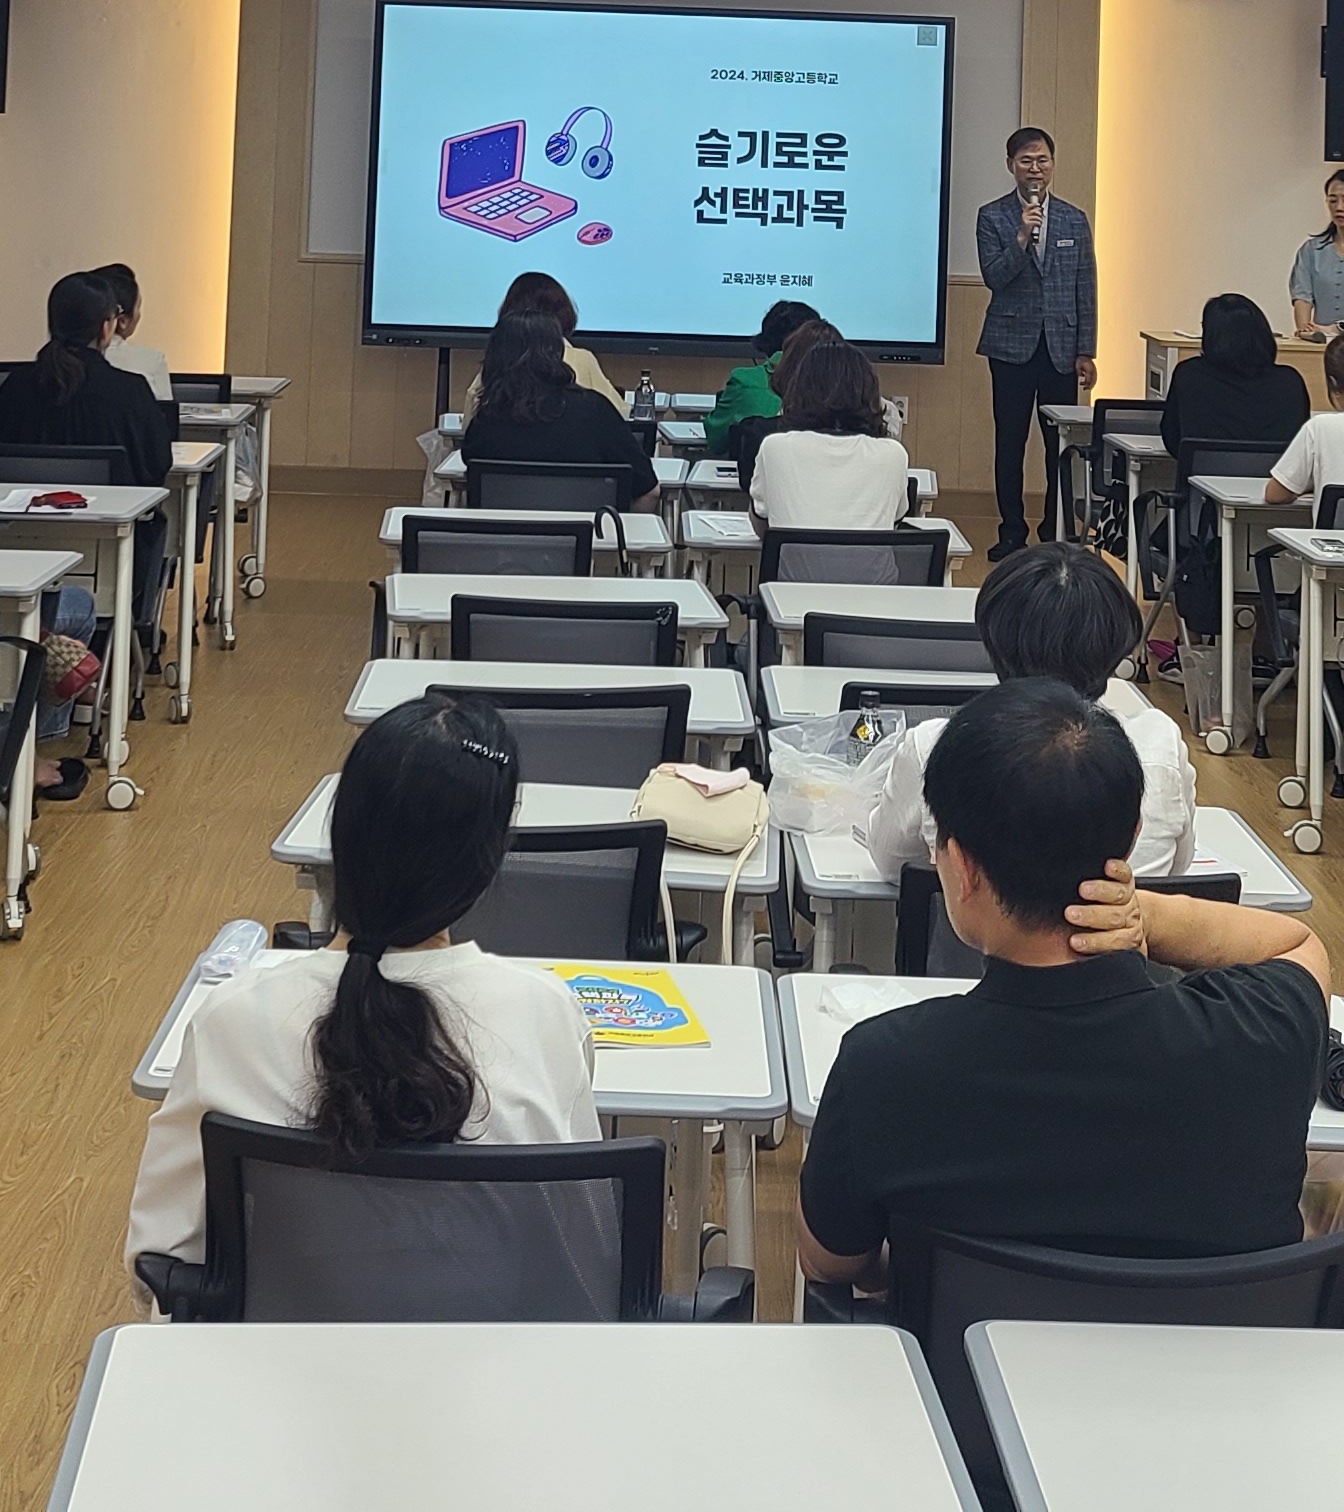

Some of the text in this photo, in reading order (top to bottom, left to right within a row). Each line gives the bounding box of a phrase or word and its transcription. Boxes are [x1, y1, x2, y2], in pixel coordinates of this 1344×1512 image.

[710, 69, 839, 85] 2024. 거제중앙고등학교
[695, 128, 849, 172] 슬기로운
[693, 186, 848, 230] 선택과목
[721, 273, 777, 286] 교육과정부
